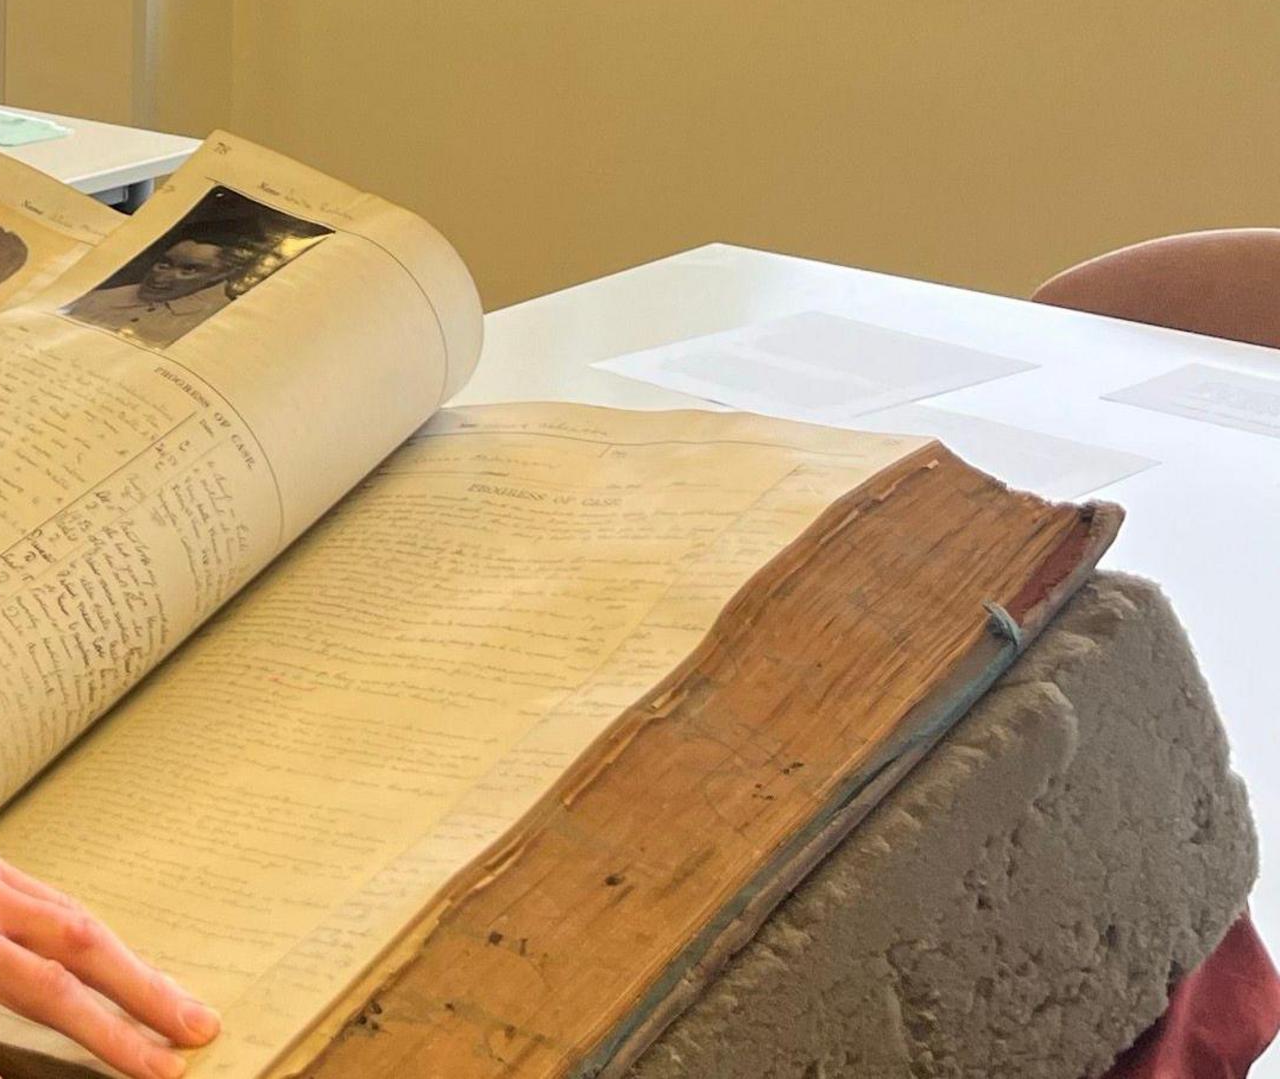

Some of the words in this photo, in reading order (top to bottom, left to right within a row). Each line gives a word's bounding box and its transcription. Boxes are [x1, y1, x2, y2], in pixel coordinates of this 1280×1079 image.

[153, 366, 210, 409] PROGRESS
[214, 411, 231, 428] OF
[467, 483, 548, 502] PROGRESS
